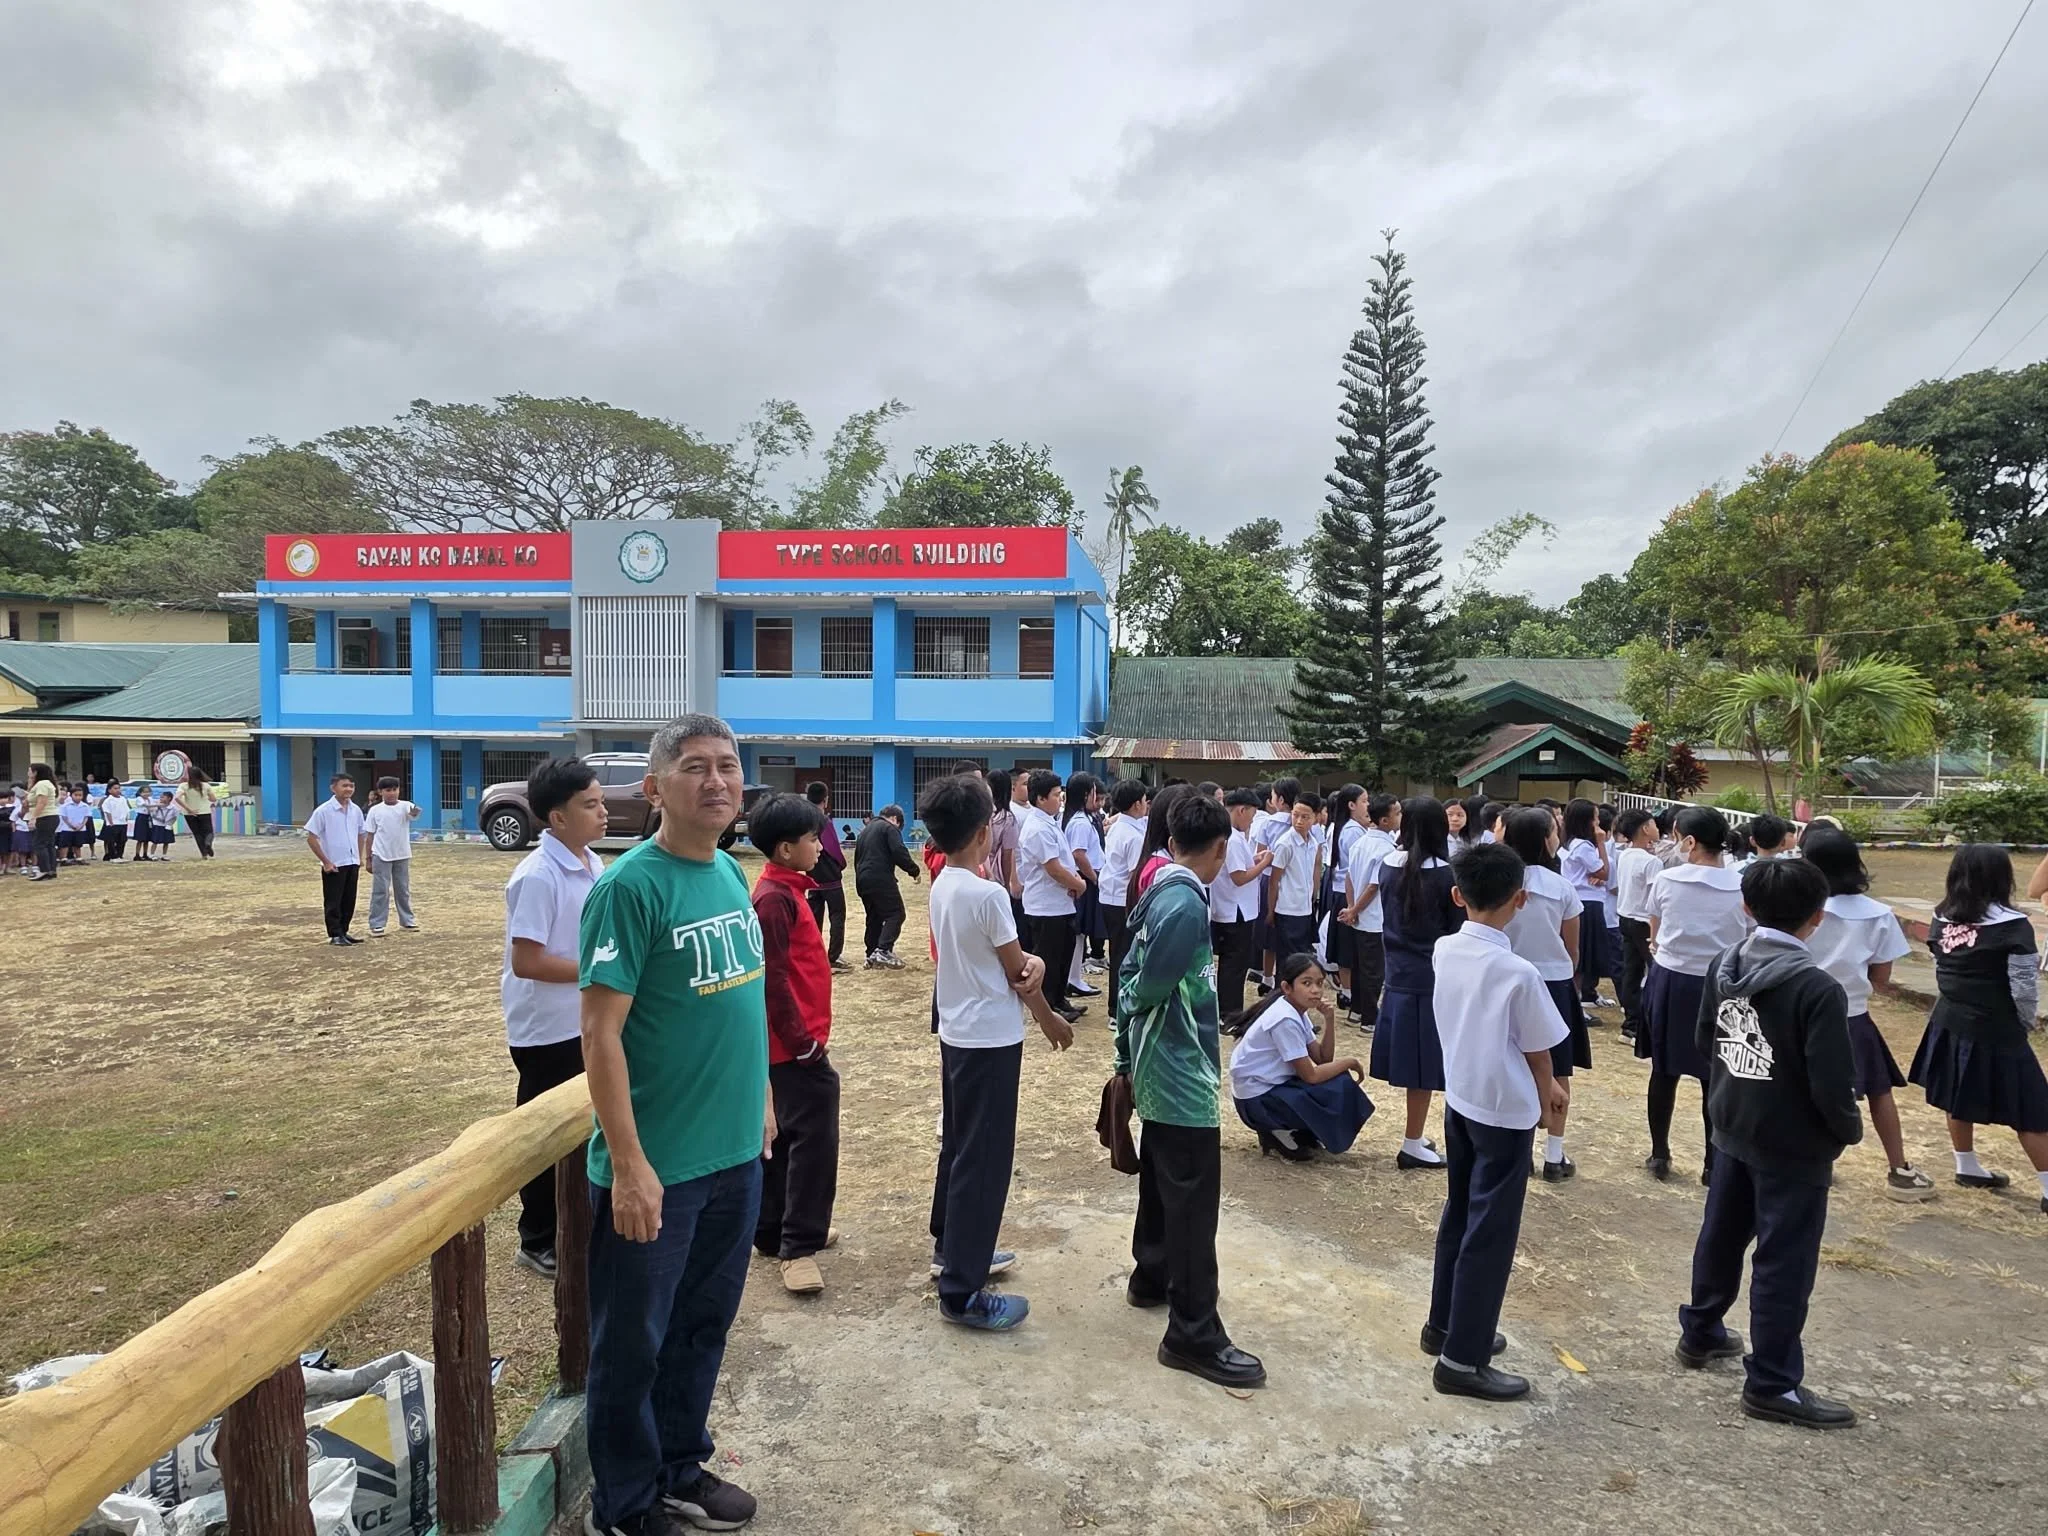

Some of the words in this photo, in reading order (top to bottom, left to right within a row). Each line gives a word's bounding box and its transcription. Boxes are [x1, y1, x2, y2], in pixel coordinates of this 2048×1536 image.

[356, 546, 411, 567] BAYAN
[418, 546, 441, 567] KO
[514, 545, 538, 567] KO
[776, 544, 824, 566] TYPE
[831, 543, 904, 566] SCHOOL
[912, 542, 1006, 565] BUILDING
[698, 984, 717, 996] FAR
[1720, 1042, 1771, 1077] DROIDS
